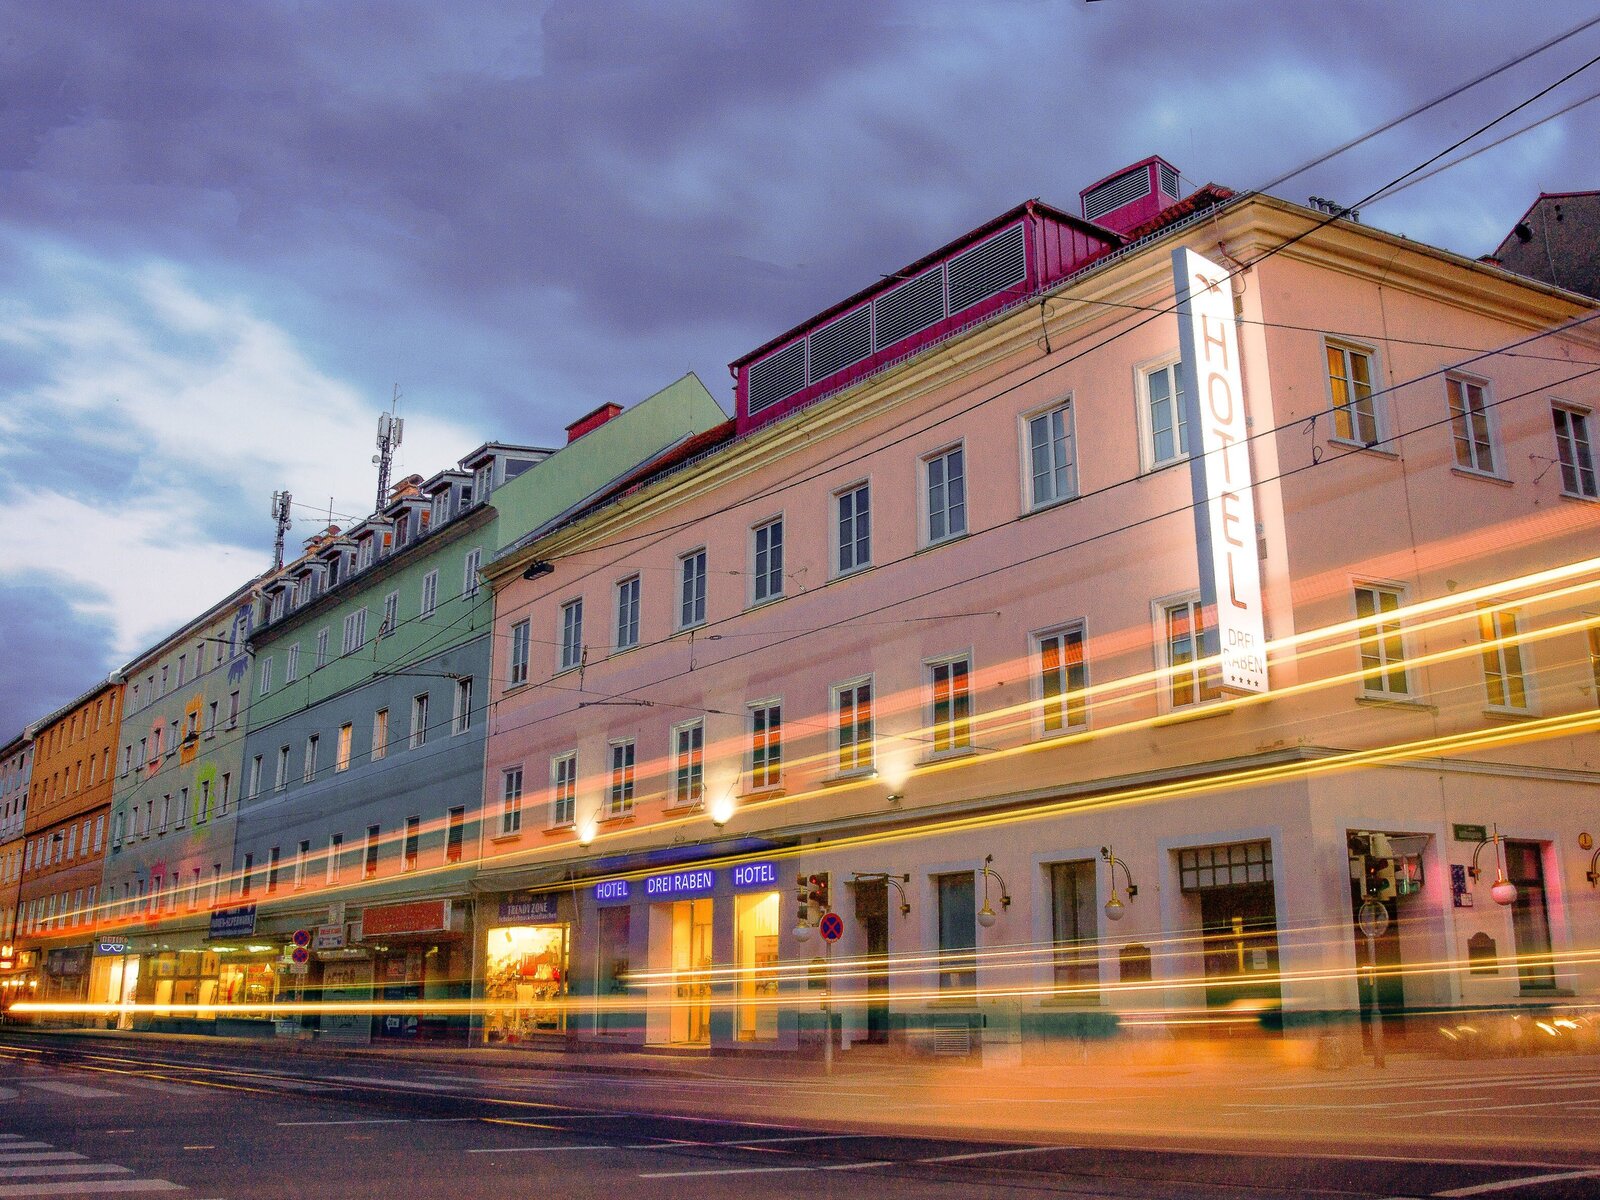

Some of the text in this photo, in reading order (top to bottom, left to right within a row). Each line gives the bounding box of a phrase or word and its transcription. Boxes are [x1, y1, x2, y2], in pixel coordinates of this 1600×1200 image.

[1201, 313, 1248, 609] HOTEL
[1228, 628, 1255, 649] DREI
[648, 871, 712, 894] DREI RABEN
[735, 864, 774, 886] HOTEL
[597, 881, 628, 899] HOTEL
